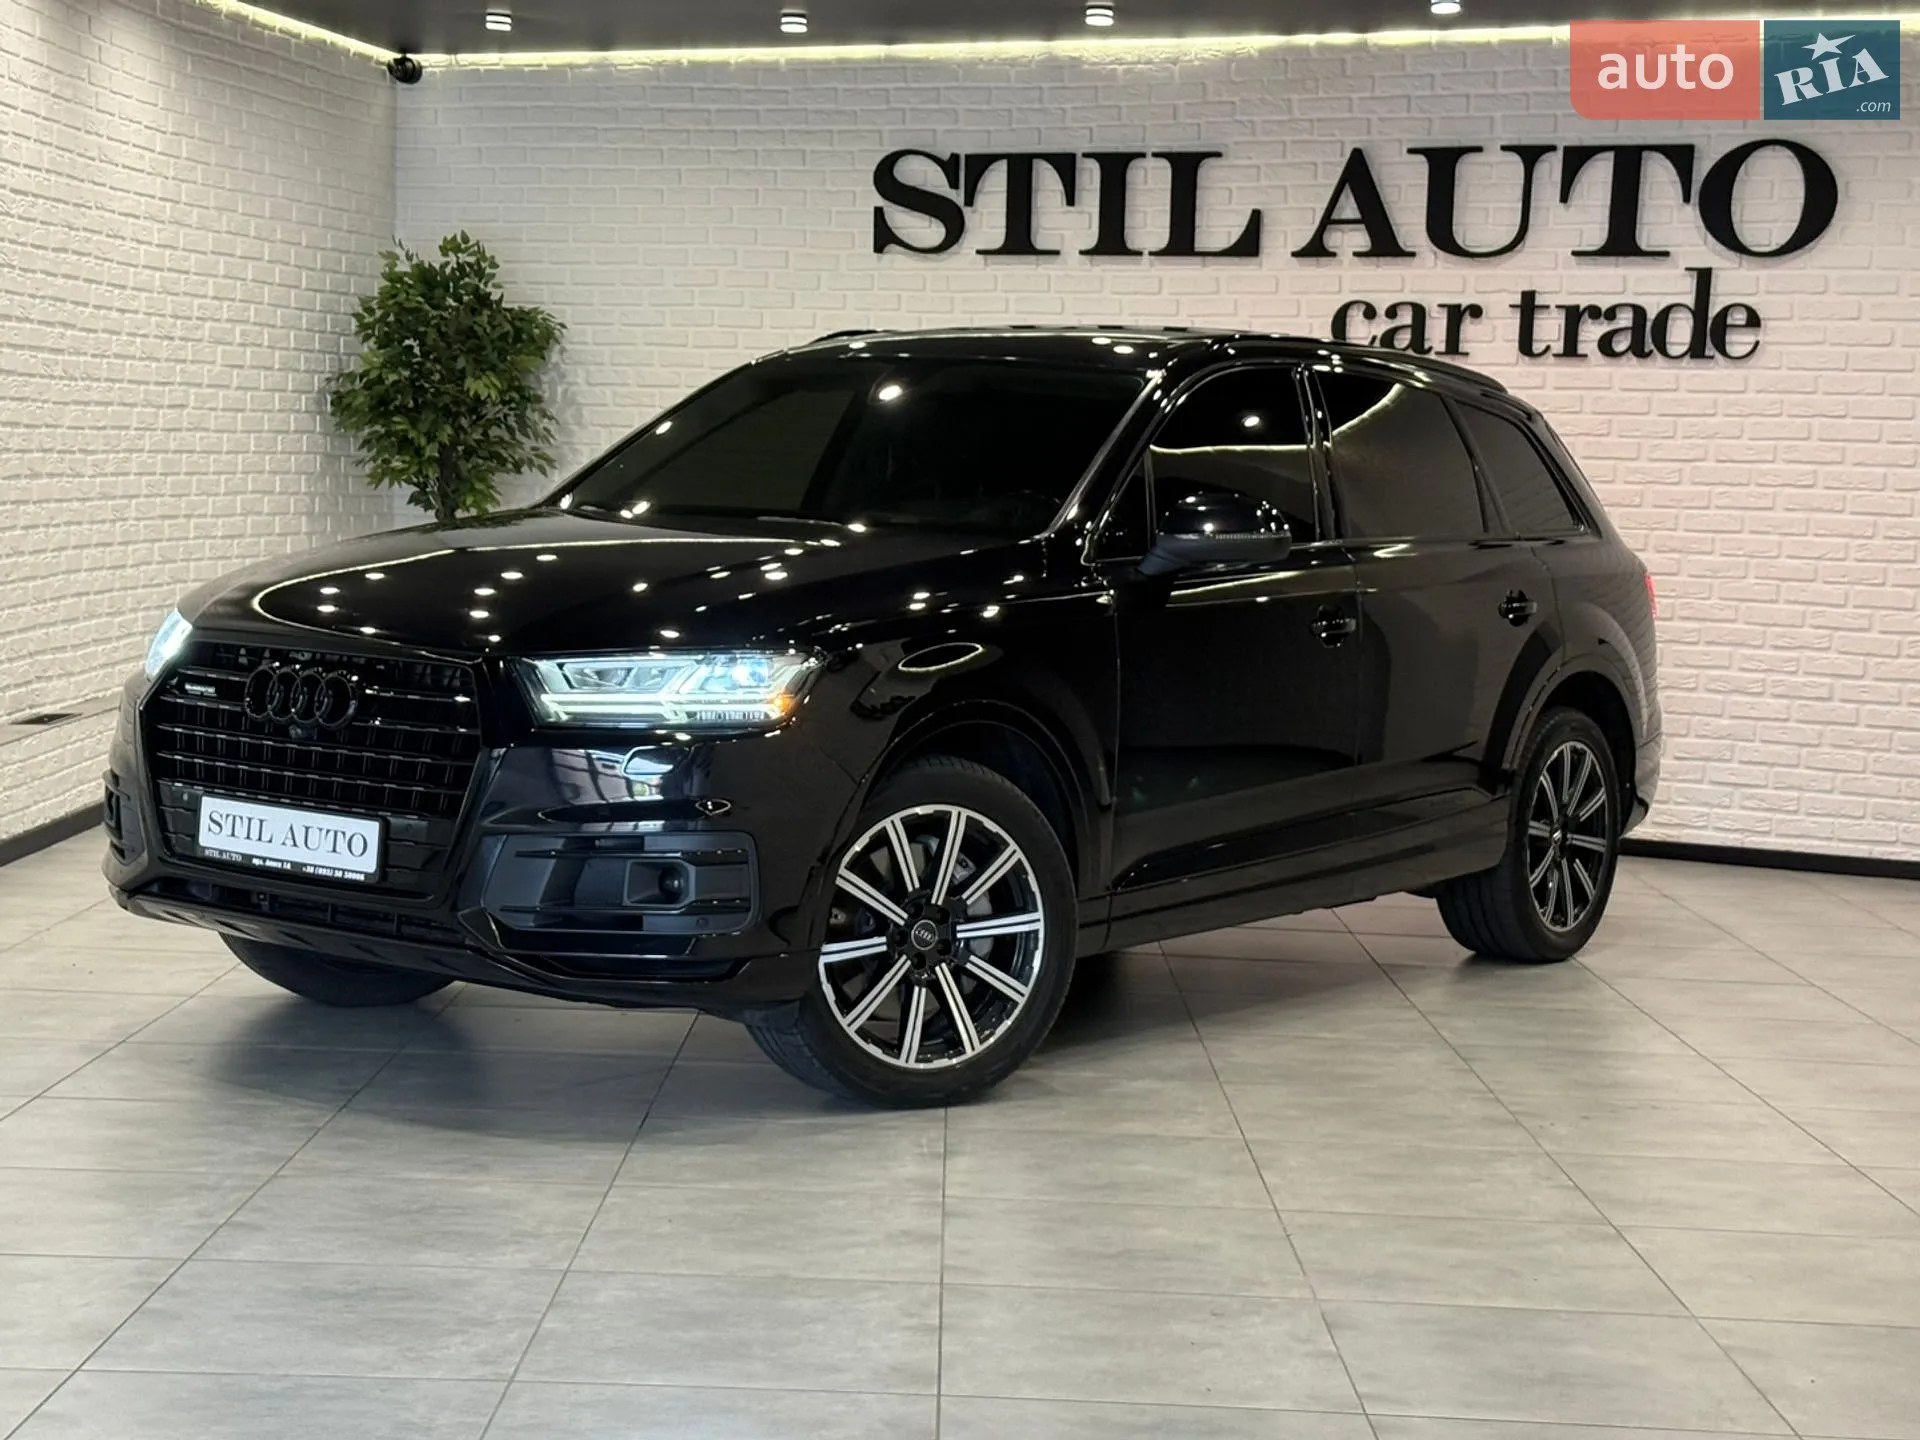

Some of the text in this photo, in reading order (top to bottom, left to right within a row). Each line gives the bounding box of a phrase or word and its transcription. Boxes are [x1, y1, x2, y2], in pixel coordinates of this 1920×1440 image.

[872, 139, 1839, 258] STIL AUTO
[1331, 268, 1762, 359] car trade
[208, 810, 368, 857] STIL AUTO
